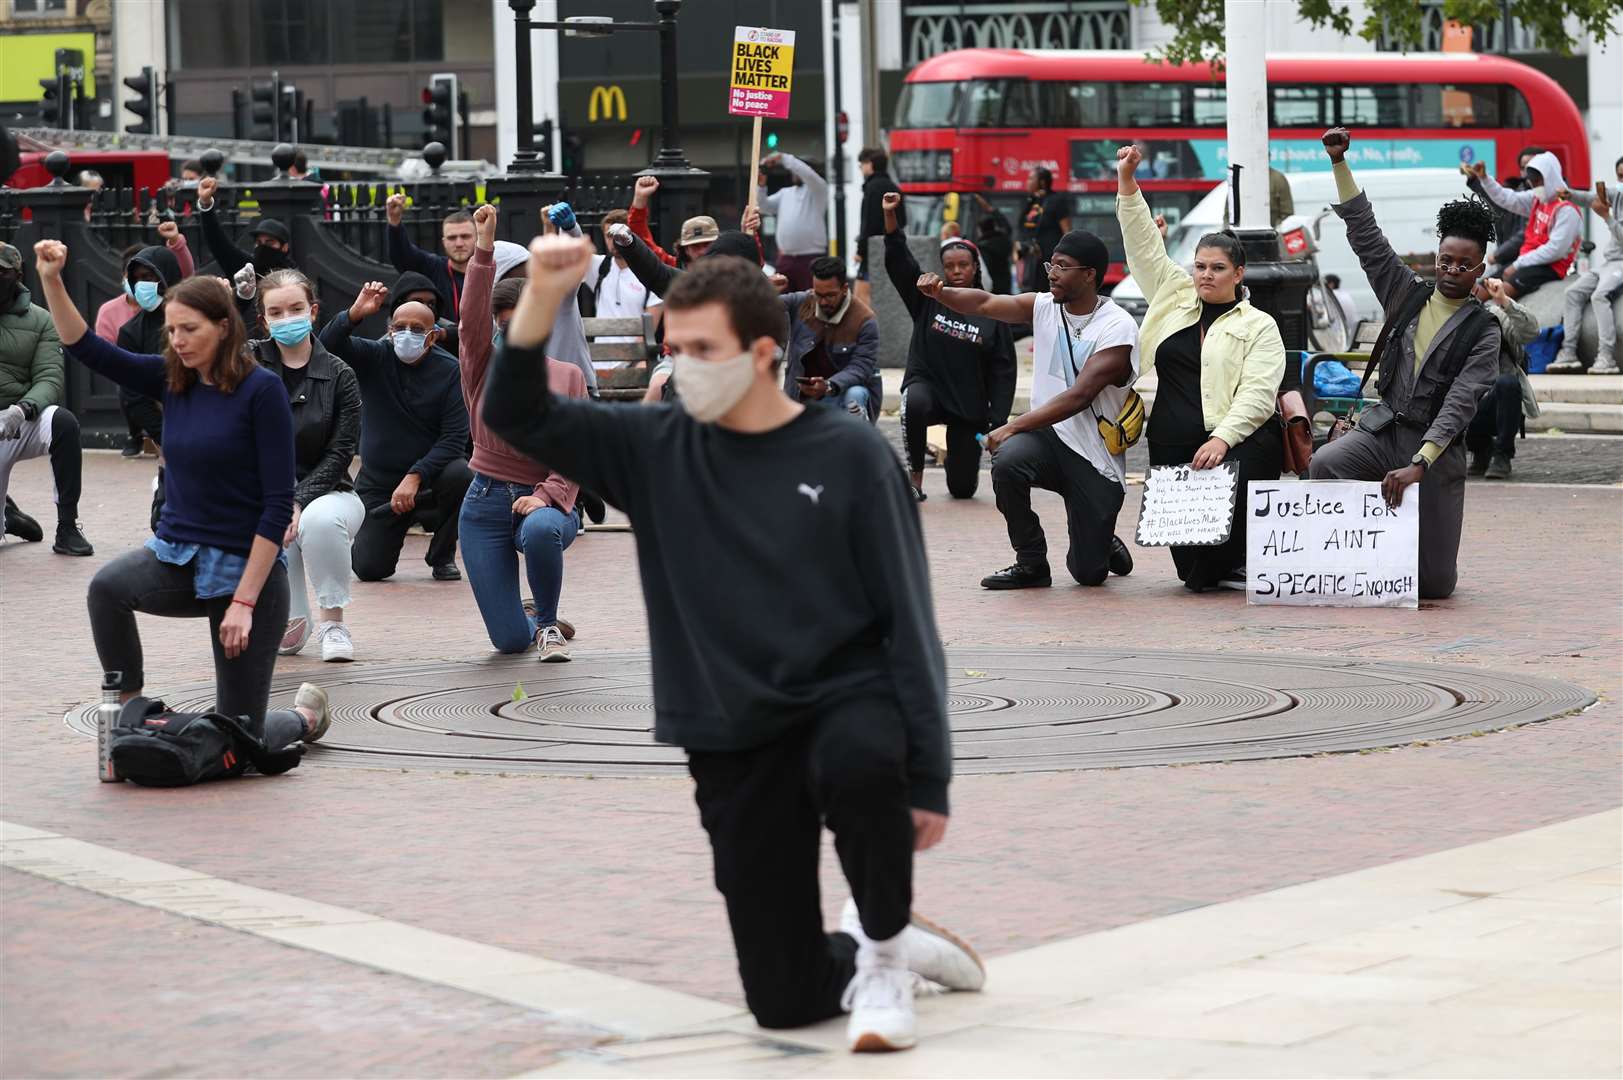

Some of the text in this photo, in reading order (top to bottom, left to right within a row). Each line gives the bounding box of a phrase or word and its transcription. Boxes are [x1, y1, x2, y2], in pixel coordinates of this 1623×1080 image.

[737, 43, 780, 59] BLACK
[735, 58, 772, 73] LIVES
[734, 72, 788, 89] MATTER
[732, 89, 773, 100] No justice
[732, 98, 769, 110] No peace
[931, 321, 984, 344] ACADEMIA
[934, 313, 980, 335] BLACK IN
[1175, 470, 1189, 481] 28
[1254, 488, 1345, 518] Justice
[1262, 528, 1386, 557] ALL AINT
[1255, 572, 1347, 599] SPECIFIC
